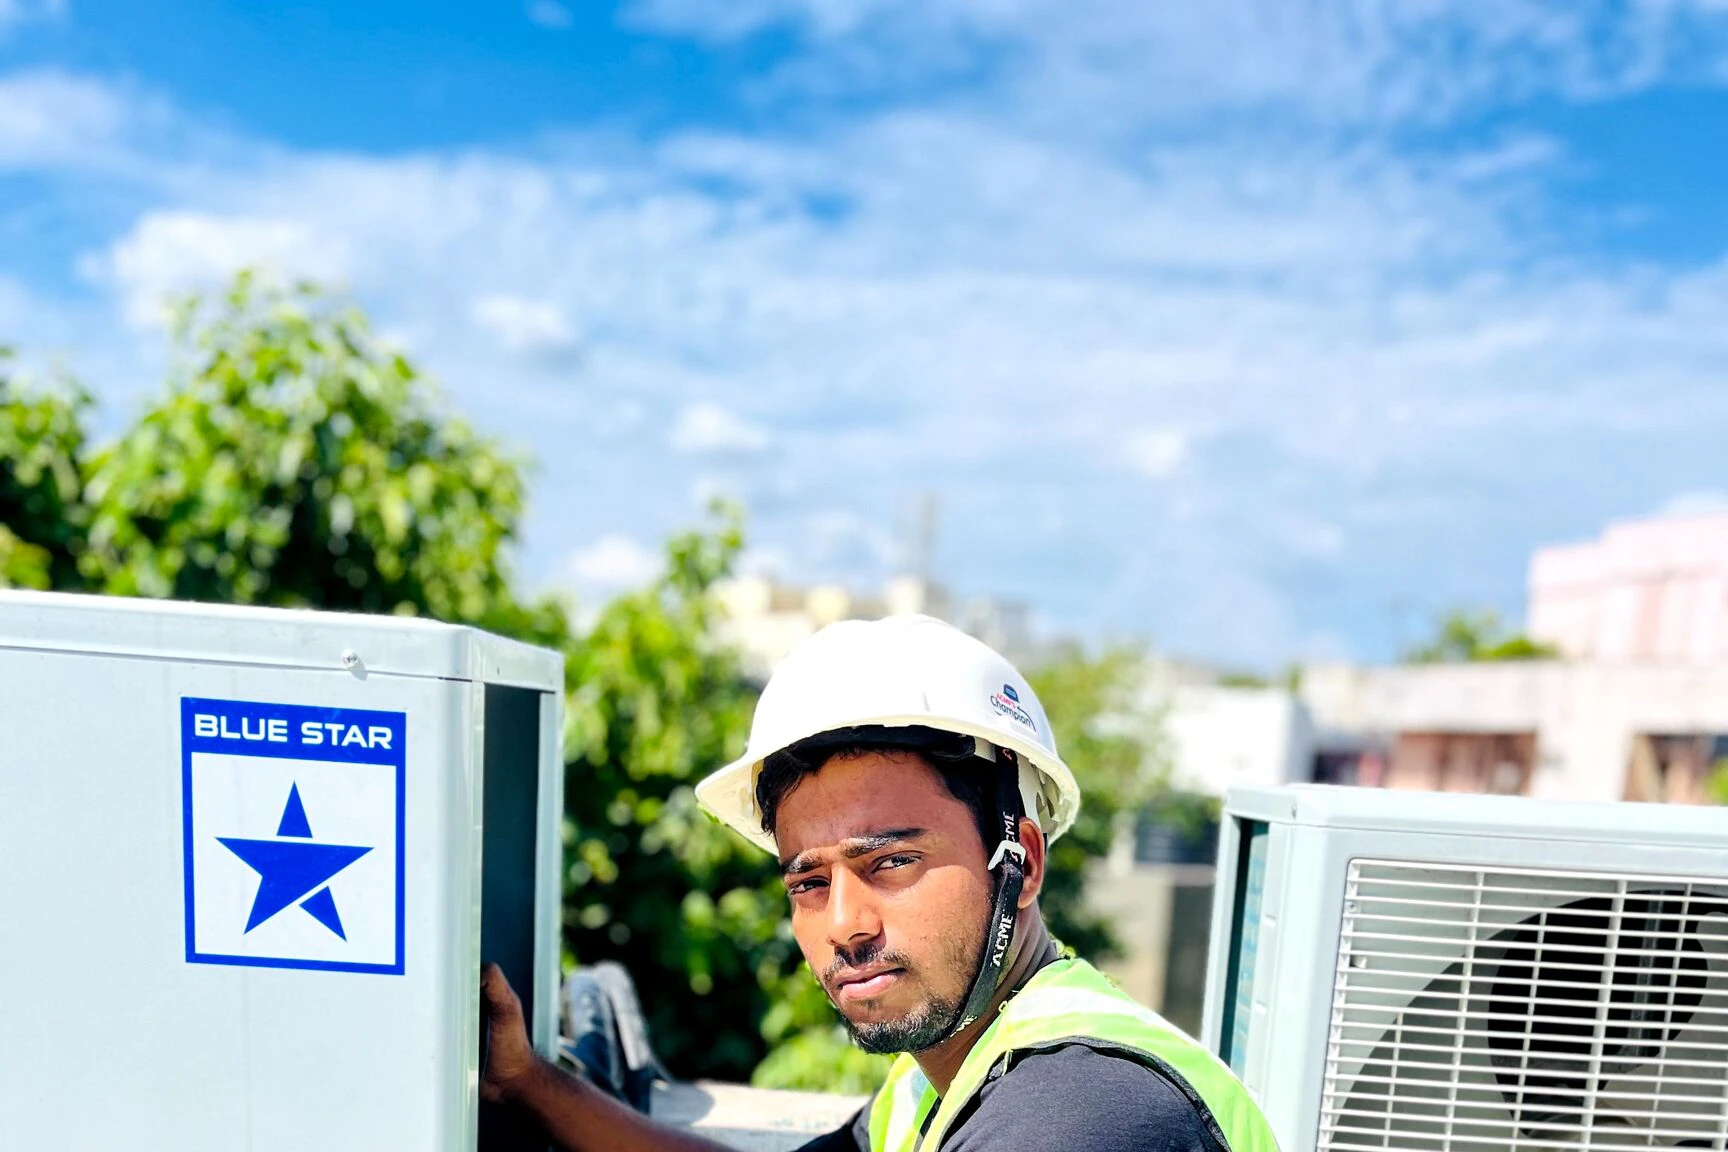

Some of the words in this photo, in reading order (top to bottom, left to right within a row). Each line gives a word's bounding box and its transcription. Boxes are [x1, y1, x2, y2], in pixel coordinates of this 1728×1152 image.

[990, 695, 1031, 727] Champion
[194, 713, 288, 742] BLUE
[301, 721, 392, 749] STAR
[990, 913, 1013, 967] ACME
